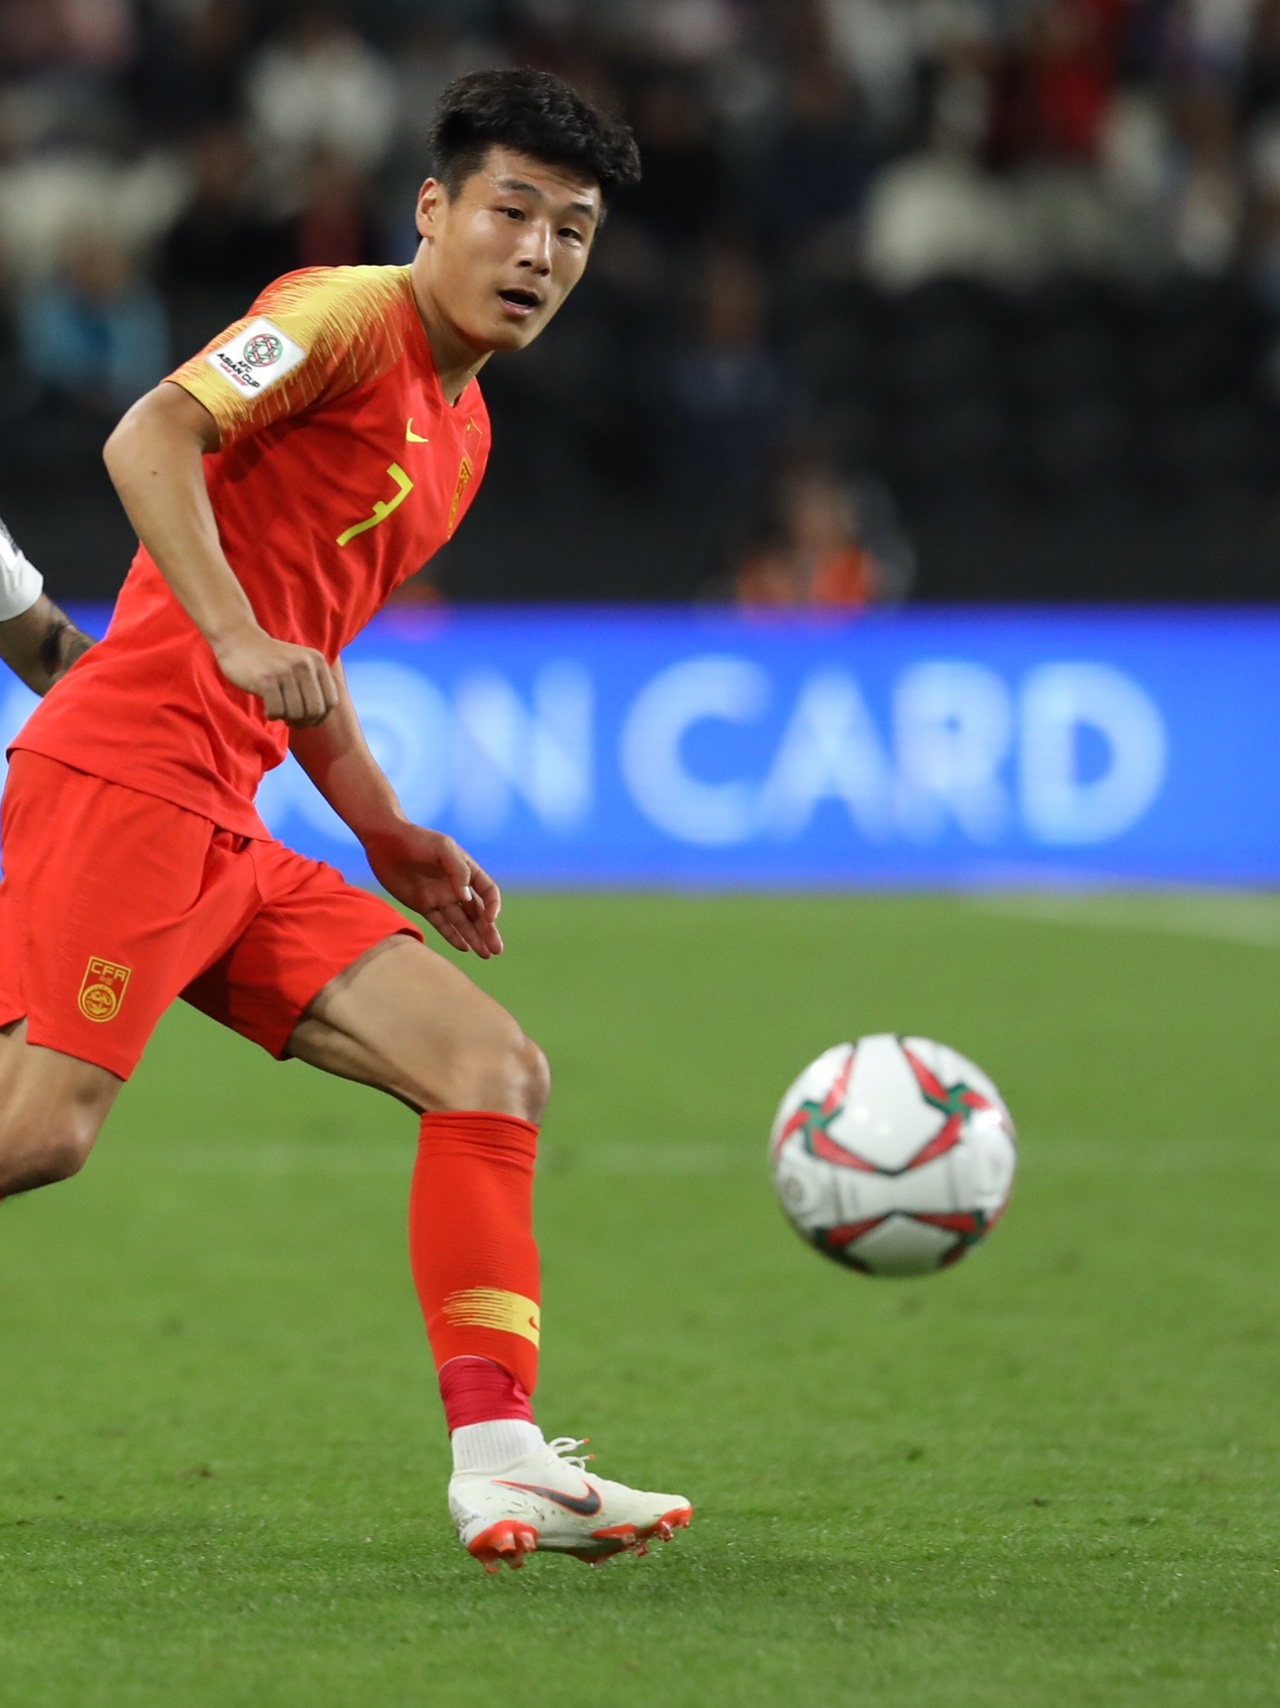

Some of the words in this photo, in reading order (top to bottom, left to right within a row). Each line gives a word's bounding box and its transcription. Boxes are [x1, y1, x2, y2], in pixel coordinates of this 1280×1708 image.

[217, 353, 242, 374] ASIAN
[242, 373, 261, 388] CUP
[237, 360, 253, 373] AFC
[336, 462, 414, 547] 7
[622, 655, 1168, 848] CARD
[91, 962, 127, 982] CFA
